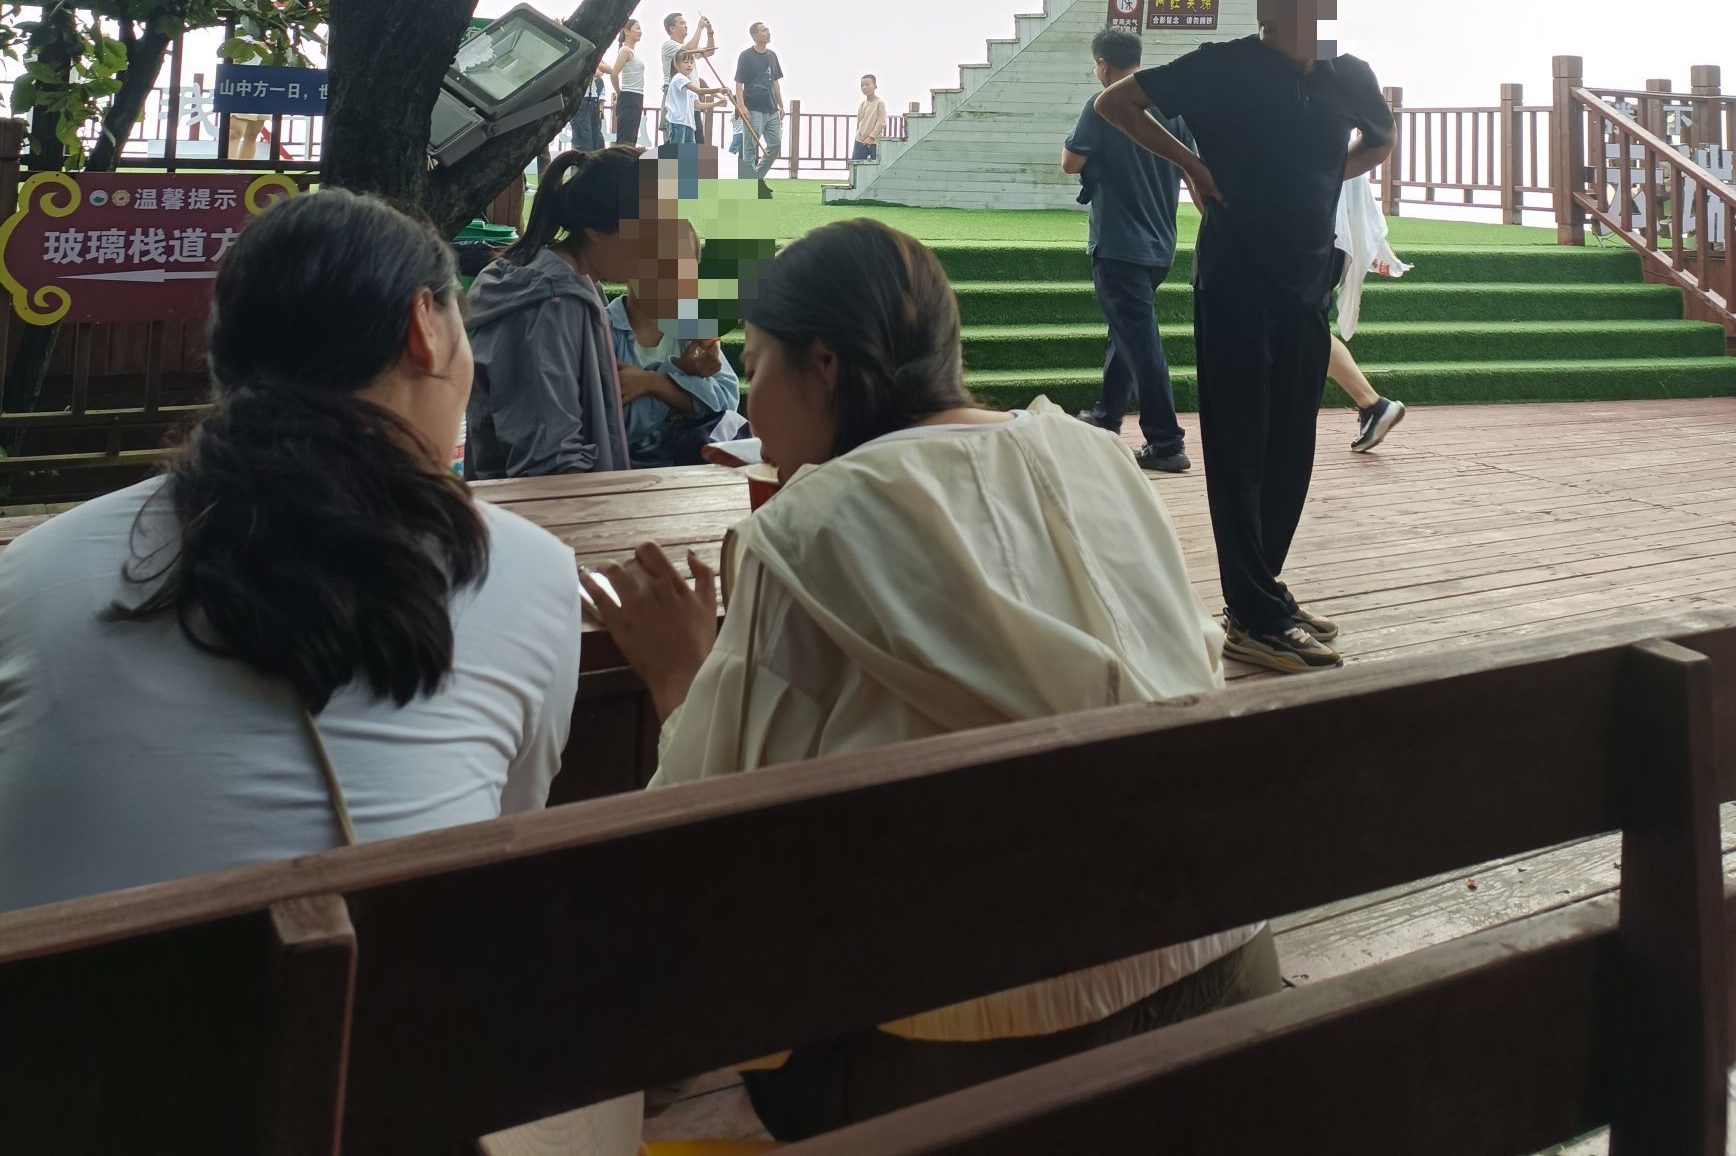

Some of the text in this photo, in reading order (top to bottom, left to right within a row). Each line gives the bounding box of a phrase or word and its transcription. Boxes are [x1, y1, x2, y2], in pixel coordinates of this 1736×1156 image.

[1152, 15, 1213, 25] 合影留念 请勿拥挤
[134, 187, 237, 210] 温馨提示
[43, 227, 239, 265] 玻璃栈道方
